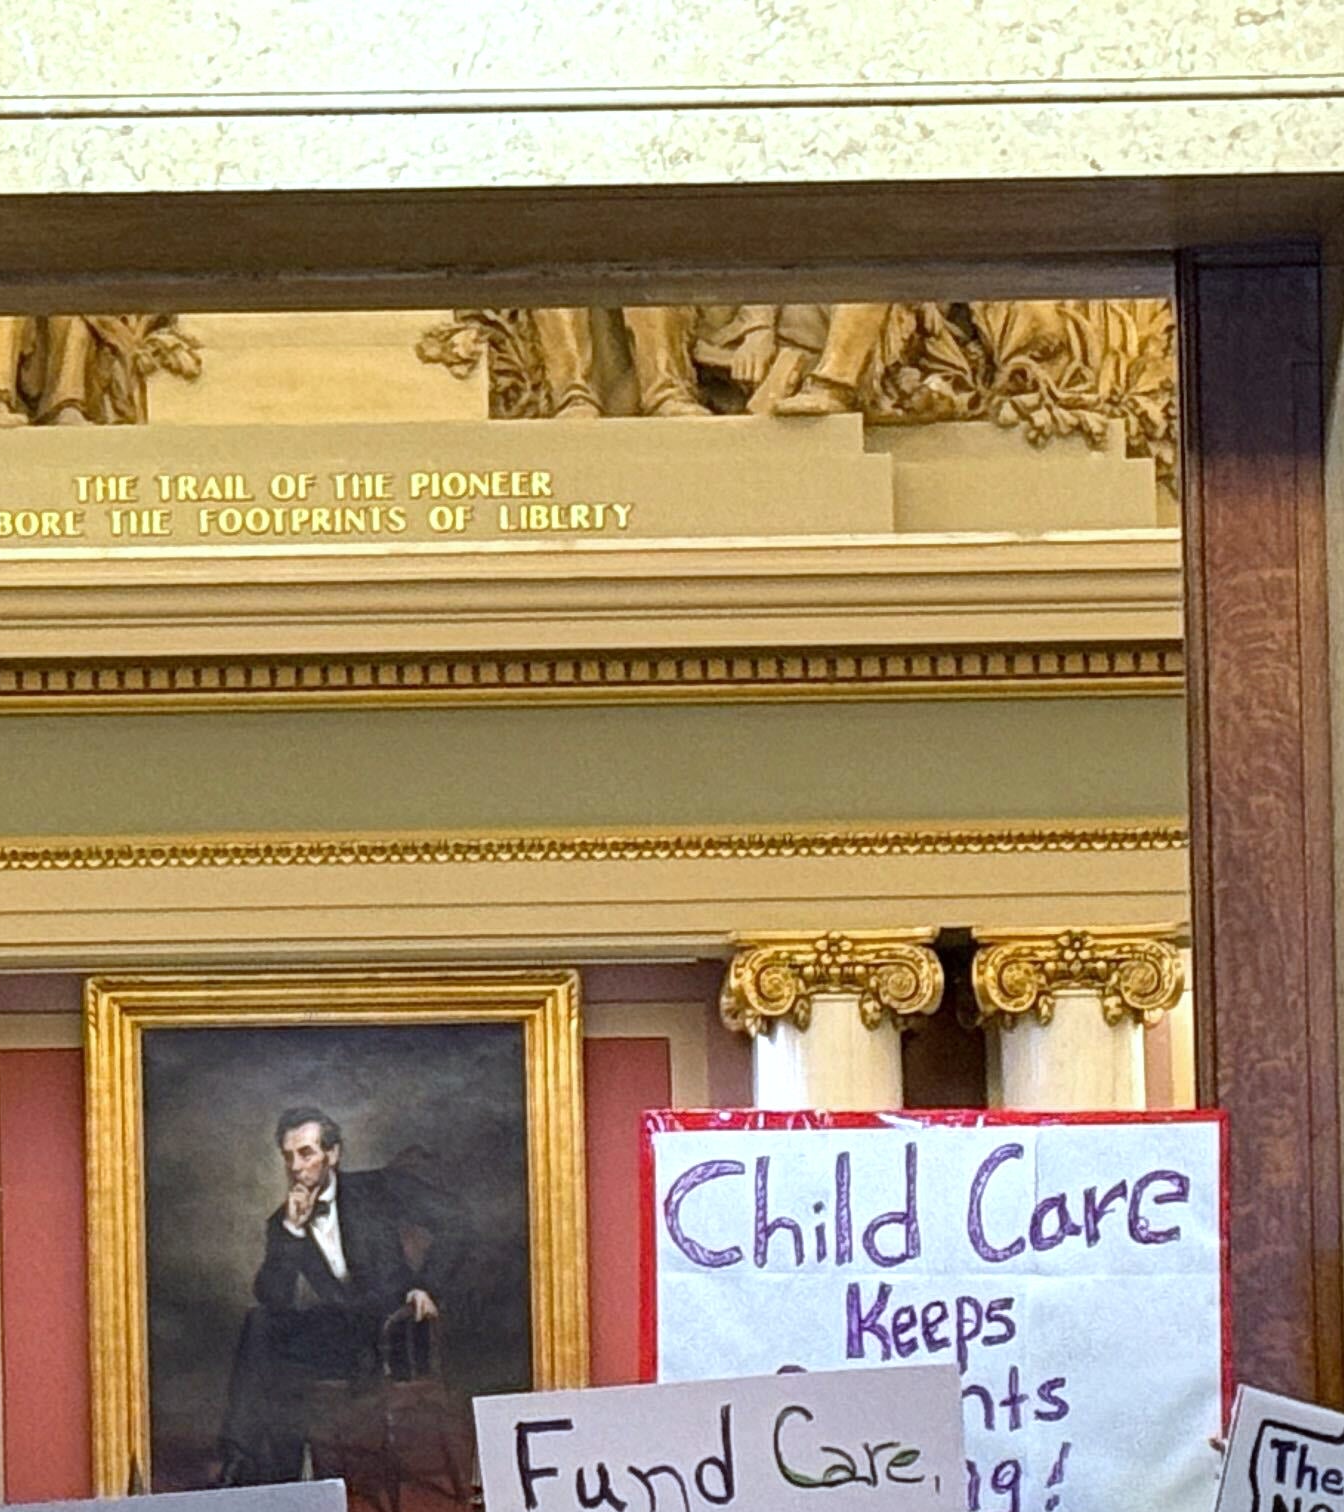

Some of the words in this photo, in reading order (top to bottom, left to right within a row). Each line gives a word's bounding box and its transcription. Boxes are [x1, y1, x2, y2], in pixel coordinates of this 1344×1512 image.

[73, 474, 138, 502] THE
[156, 472, 251, 501] TRAIL
[269, 472, 317, 500] OF
[333, 471, 394, 499] THE
[410, 470, 553, 499] PIONEER
[109, 507, 171, 536] THE
[198, 504, 407, 535] FOOTPRINTS
[427, 503, 476, 532] OF
[500, 501, 634, 531] LIBERTY
[662, 1141, 922, 1270] Child
[967, 1142, 1191, 1264] Care
[845, 1281, 1017, 1375] Keeps
